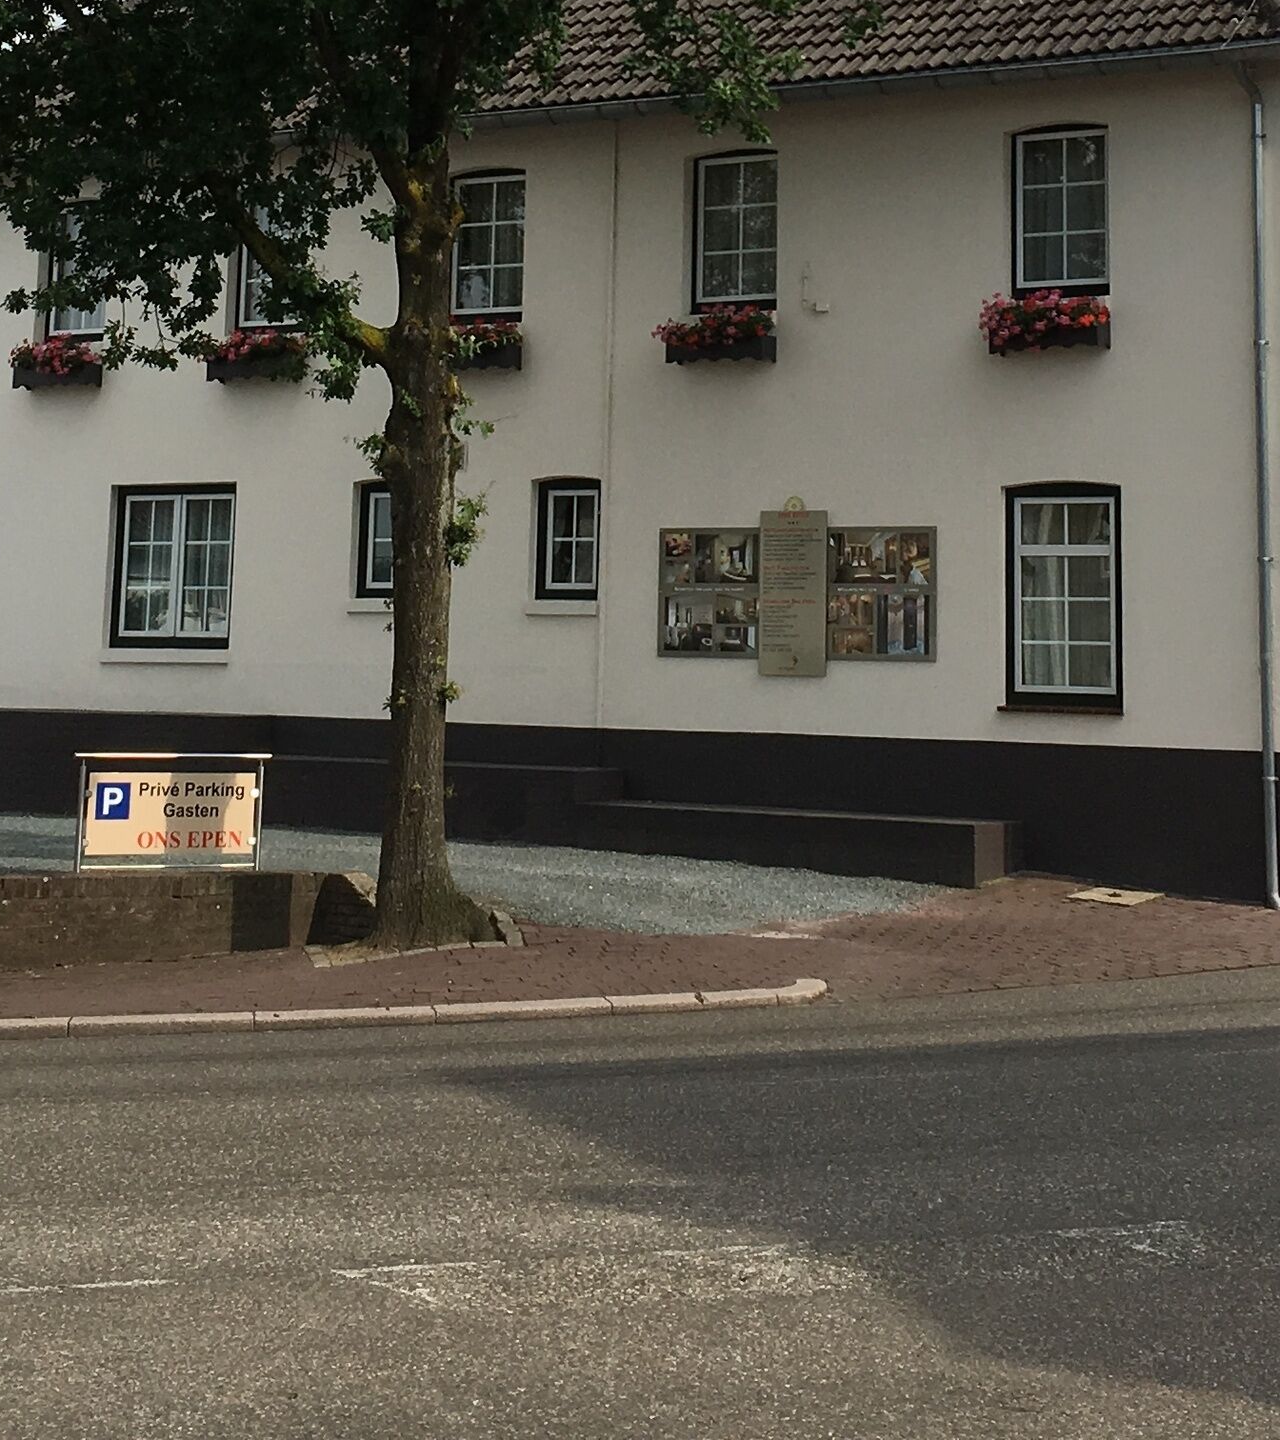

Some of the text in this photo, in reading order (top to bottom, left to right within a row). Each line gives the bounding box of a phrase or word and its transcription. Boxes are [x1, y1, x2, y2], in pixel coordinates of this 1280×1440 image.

[139, 782, 245, 800] Privé Parking
[102, 787, 124, 815] P
[163, 803, 219, 818] Gasten
[137, 830, 242, 849] ONS EPEN
